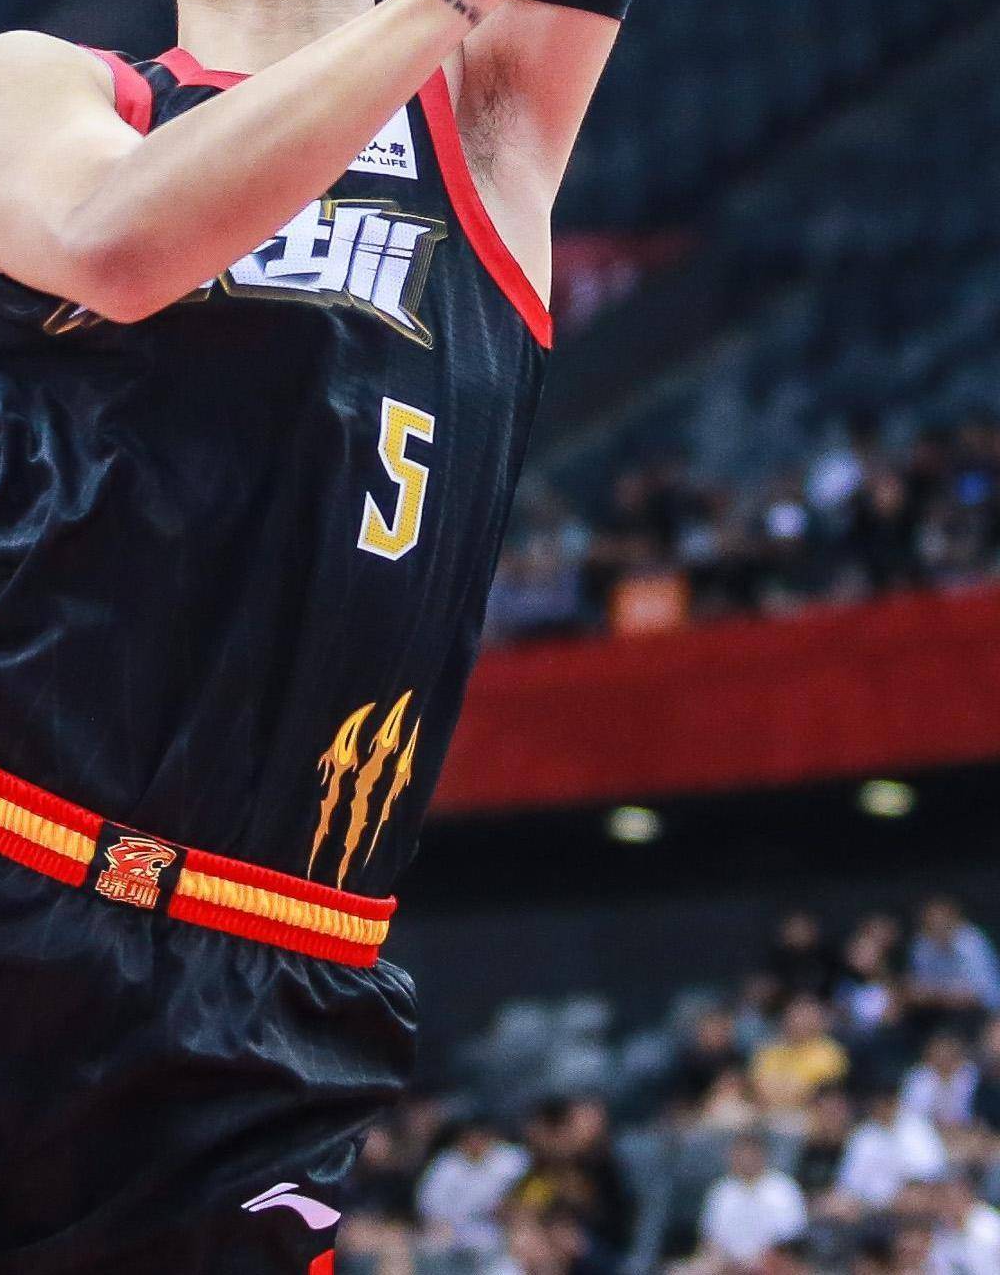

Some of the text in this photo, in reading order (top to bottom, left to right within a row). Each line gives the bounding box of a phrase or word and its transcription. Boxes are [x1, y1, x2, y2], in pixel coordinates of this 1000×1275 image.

[361, 141, 406, 158] 人寿
[379, 157, 408, 168] LIFE
[43, 199, 447, 350] 圳
[357, 396, 436, 561] 5
